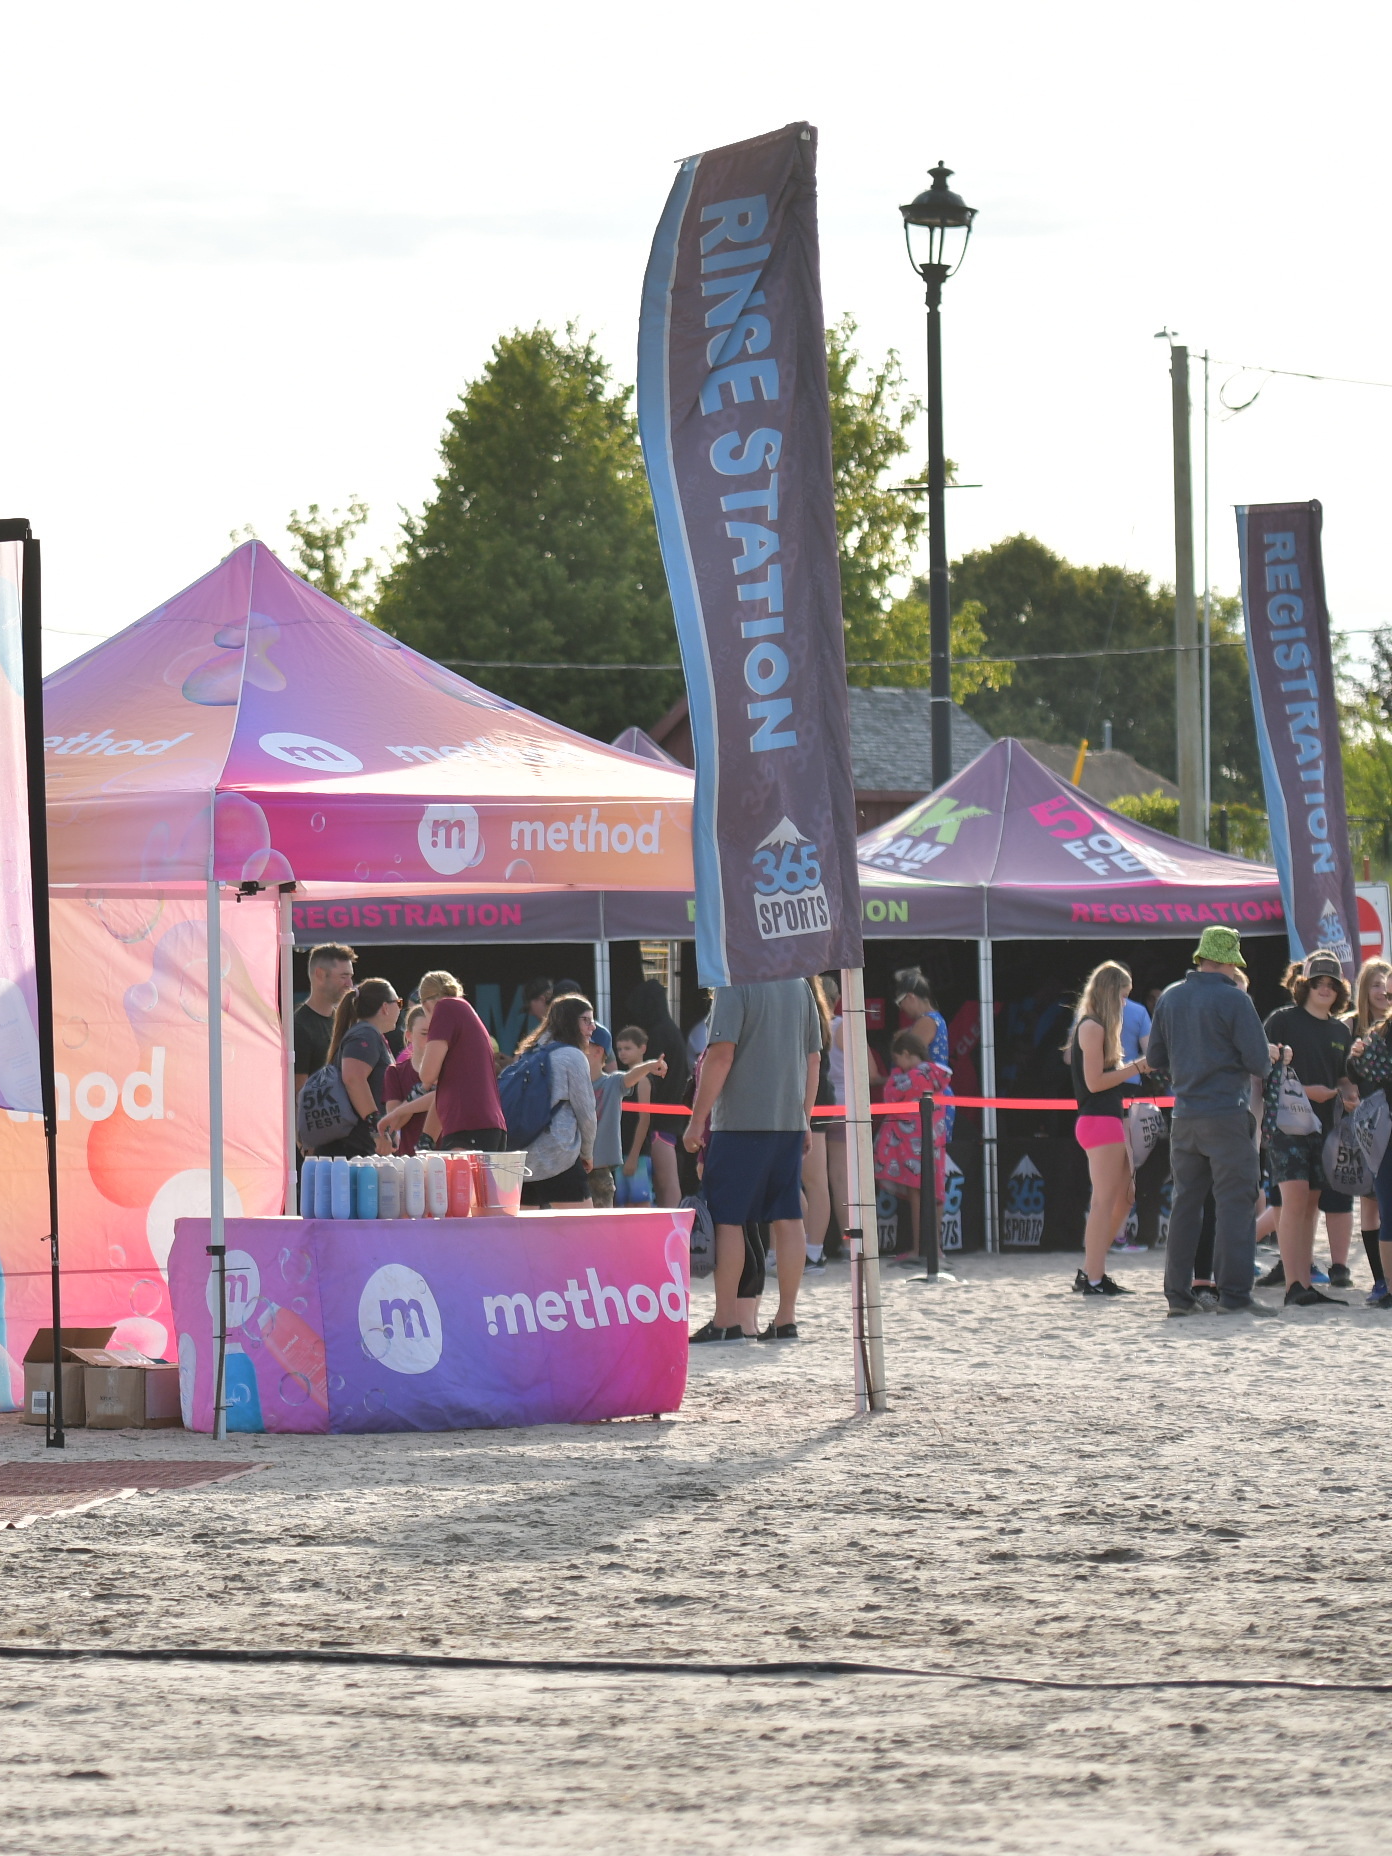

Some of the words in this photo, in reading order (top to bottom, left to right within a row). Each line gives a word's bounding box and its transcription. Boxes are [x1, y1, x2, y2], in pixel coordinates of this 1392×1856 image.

[697, 193, 780, 415] RINSE
[709, 429, 799, 755] STATION
[1262, 531, 1337, 875] REGISTRATION
[44, 728, 194, 756] ethod
[510, 807, 663, 854] method
[752, 844, 822, 896] 365
[292, 903, 522, 930] REGISTRATION
[759, 895, 829, 935] SPORTS
[1071, 900, 1285, 924] REGISTRATION
[303, 1084, 338, 1110] 5K
[305, 1104, 342, 1122] FOAM
[307, 1114, 342, 1132] FEST
[1008, 1175, 1046, 1214] 365
[1005, 1218, 1044, 1244] SPORTS
[483, 1262, 689, 1336] method
